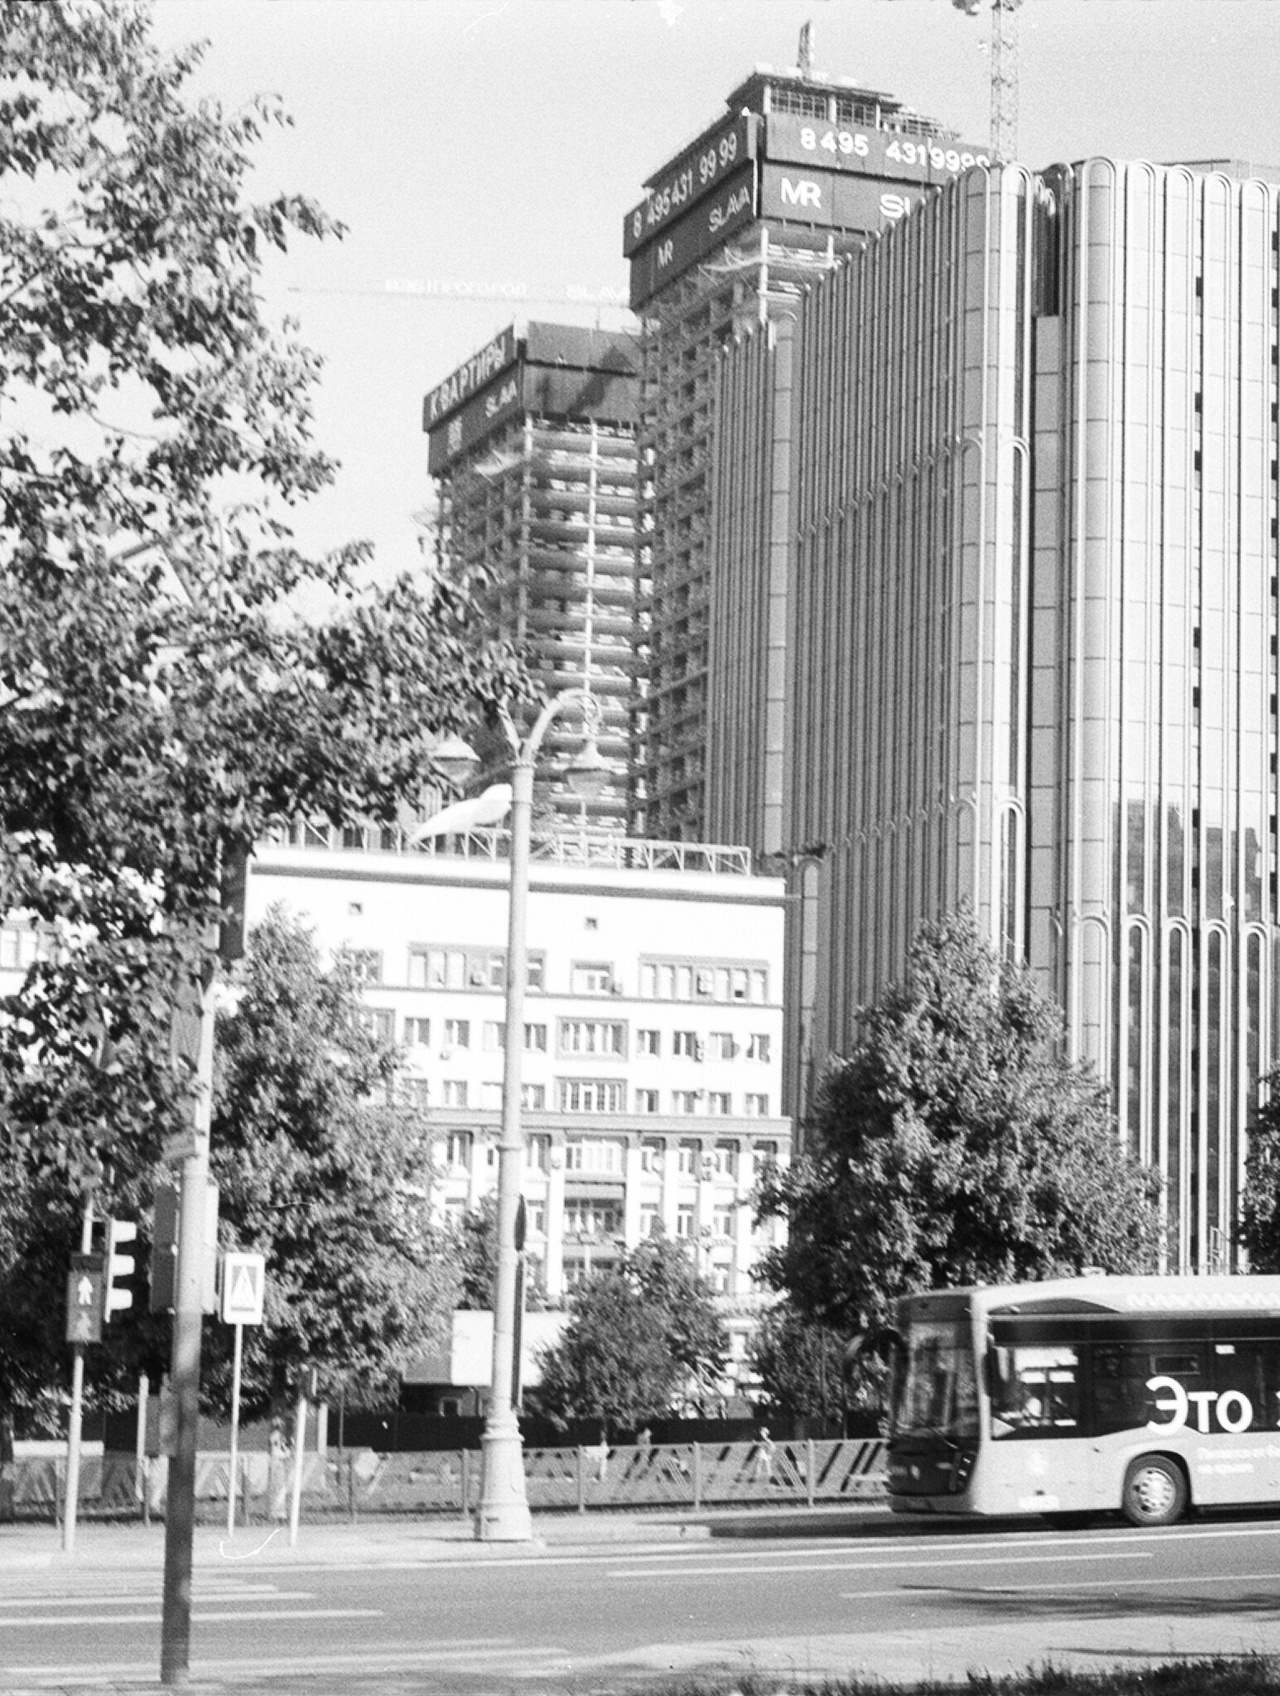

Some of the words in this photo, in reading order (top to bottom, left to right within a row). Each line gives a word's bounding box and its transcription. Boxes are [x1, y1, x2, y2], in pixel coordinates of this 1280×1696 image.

[709, 185, 751, 233] SLAVA
[780, 177, 822, 209] MR
[1145, 1375, 1253, 1436] Это
